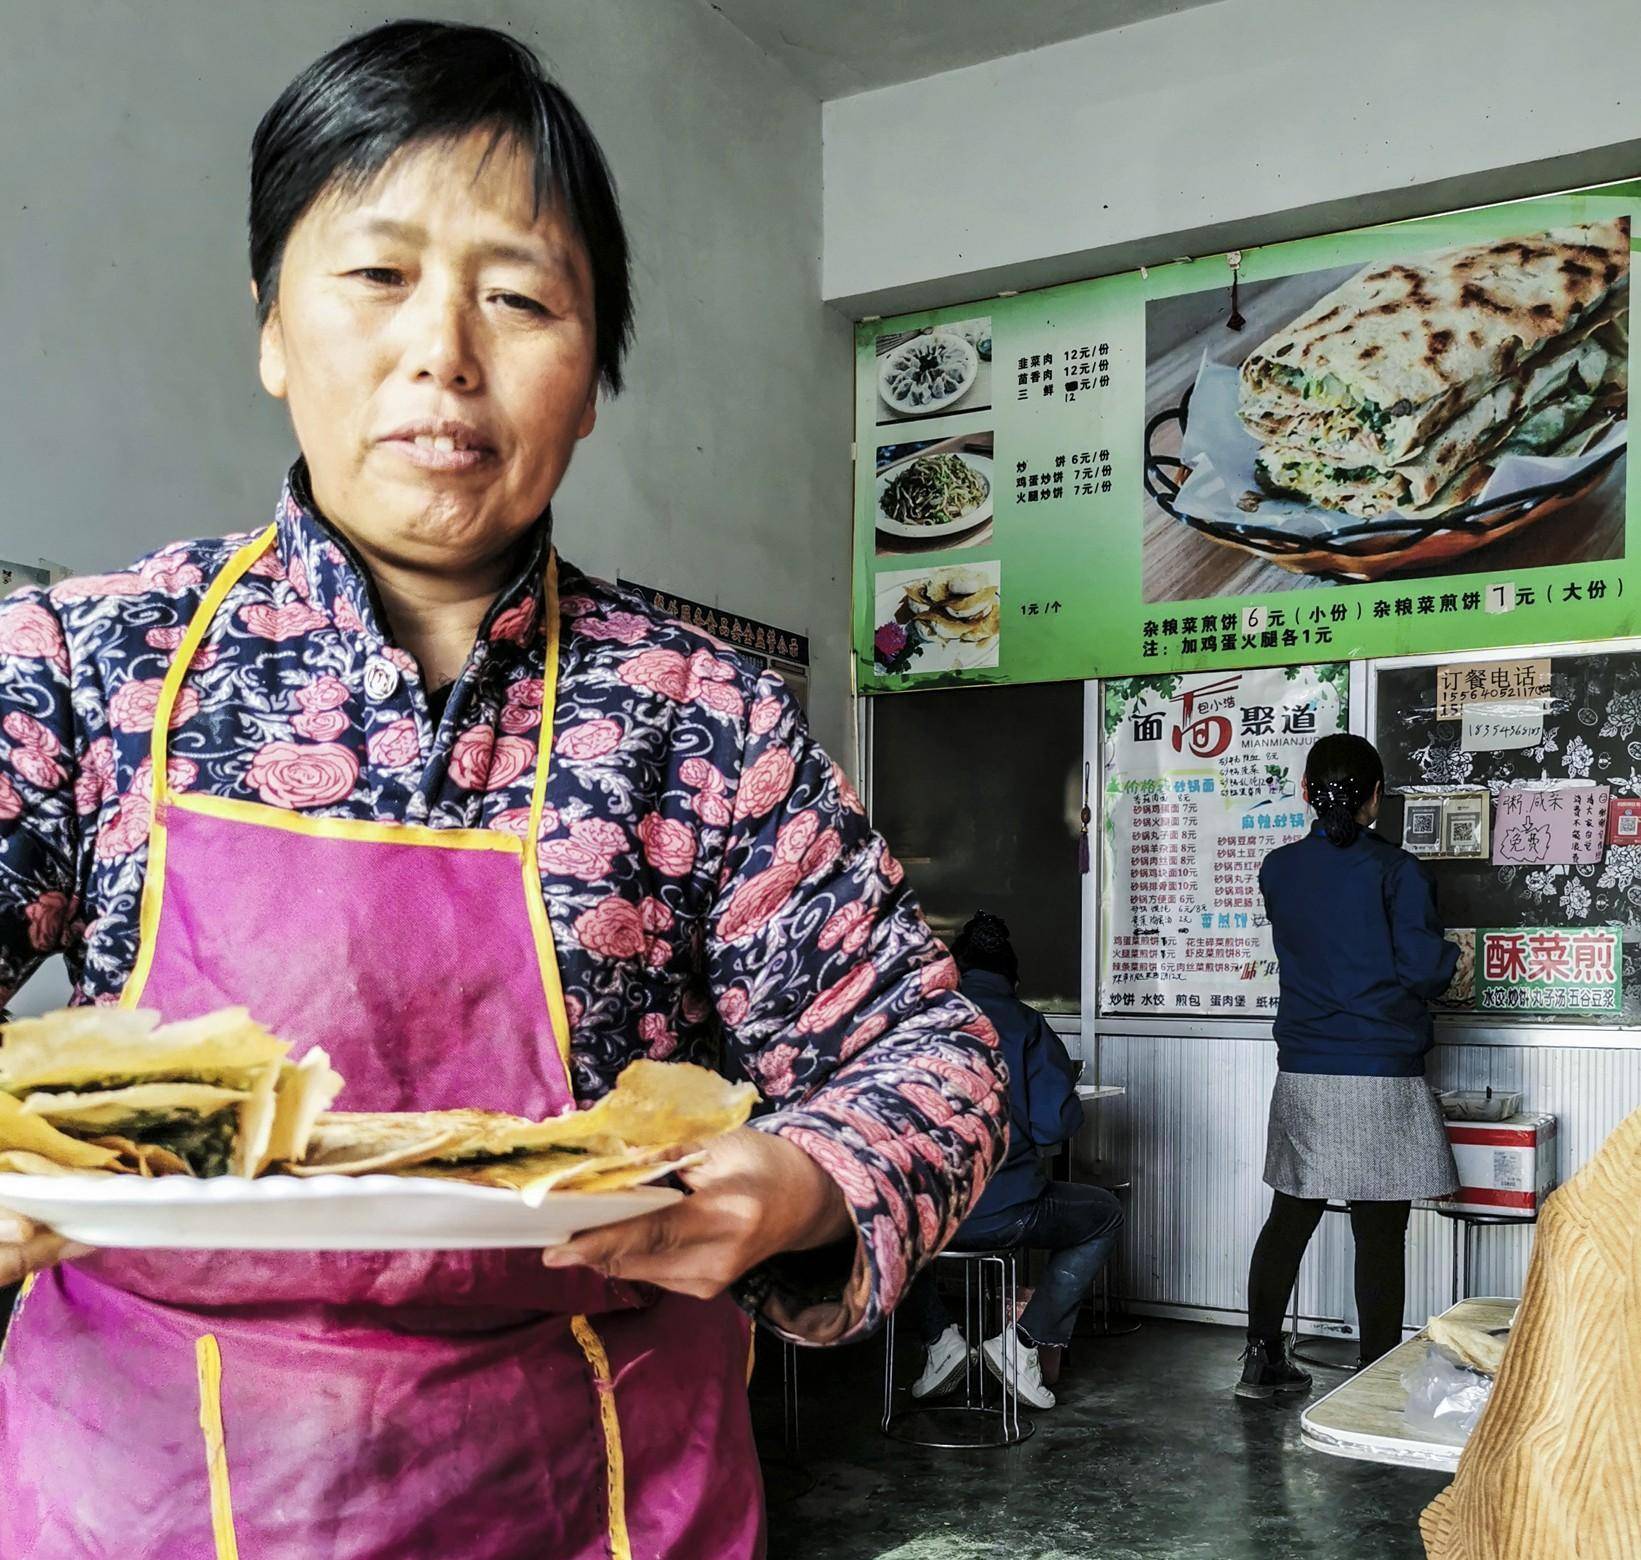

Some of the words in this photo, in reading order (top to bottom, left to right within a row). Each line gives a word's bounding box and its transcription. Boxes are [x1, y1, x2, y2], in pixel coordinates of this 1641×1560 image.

[1064, 343, 1109, 361] 12元/份
[1064, 359, 1109, 376] 12元/份
[1065, 393, 1076, 402] 12
[1072, 450, 1110, 464] 6元/份
[1016, 471, 1063, 488] 鸡蛋炒饼
[1074, 465, 1112, 480] 7元/份
[1016, 487, 1063, 504] 火腿炒饼
[1074, 480, 1112, 495] 7元/份
[1441, 665, 1536, 690] 订餐电话
[1509, 833, 1540, 854] 免费
[1485, 933, 1615, 980] 酥菜煎
[1108, 993, 1135, 1006] 炒饼
[1141, 994, 1165, 1006] 水饺
[1175, 994, 1200, 1007] 煎包
[1210, 994, 1246, 1007] 蛋肉堡
[1532, 988, 1566, 1007] 丸子汤
[1568, 988, 1615, 1007] 五谷豆浆
